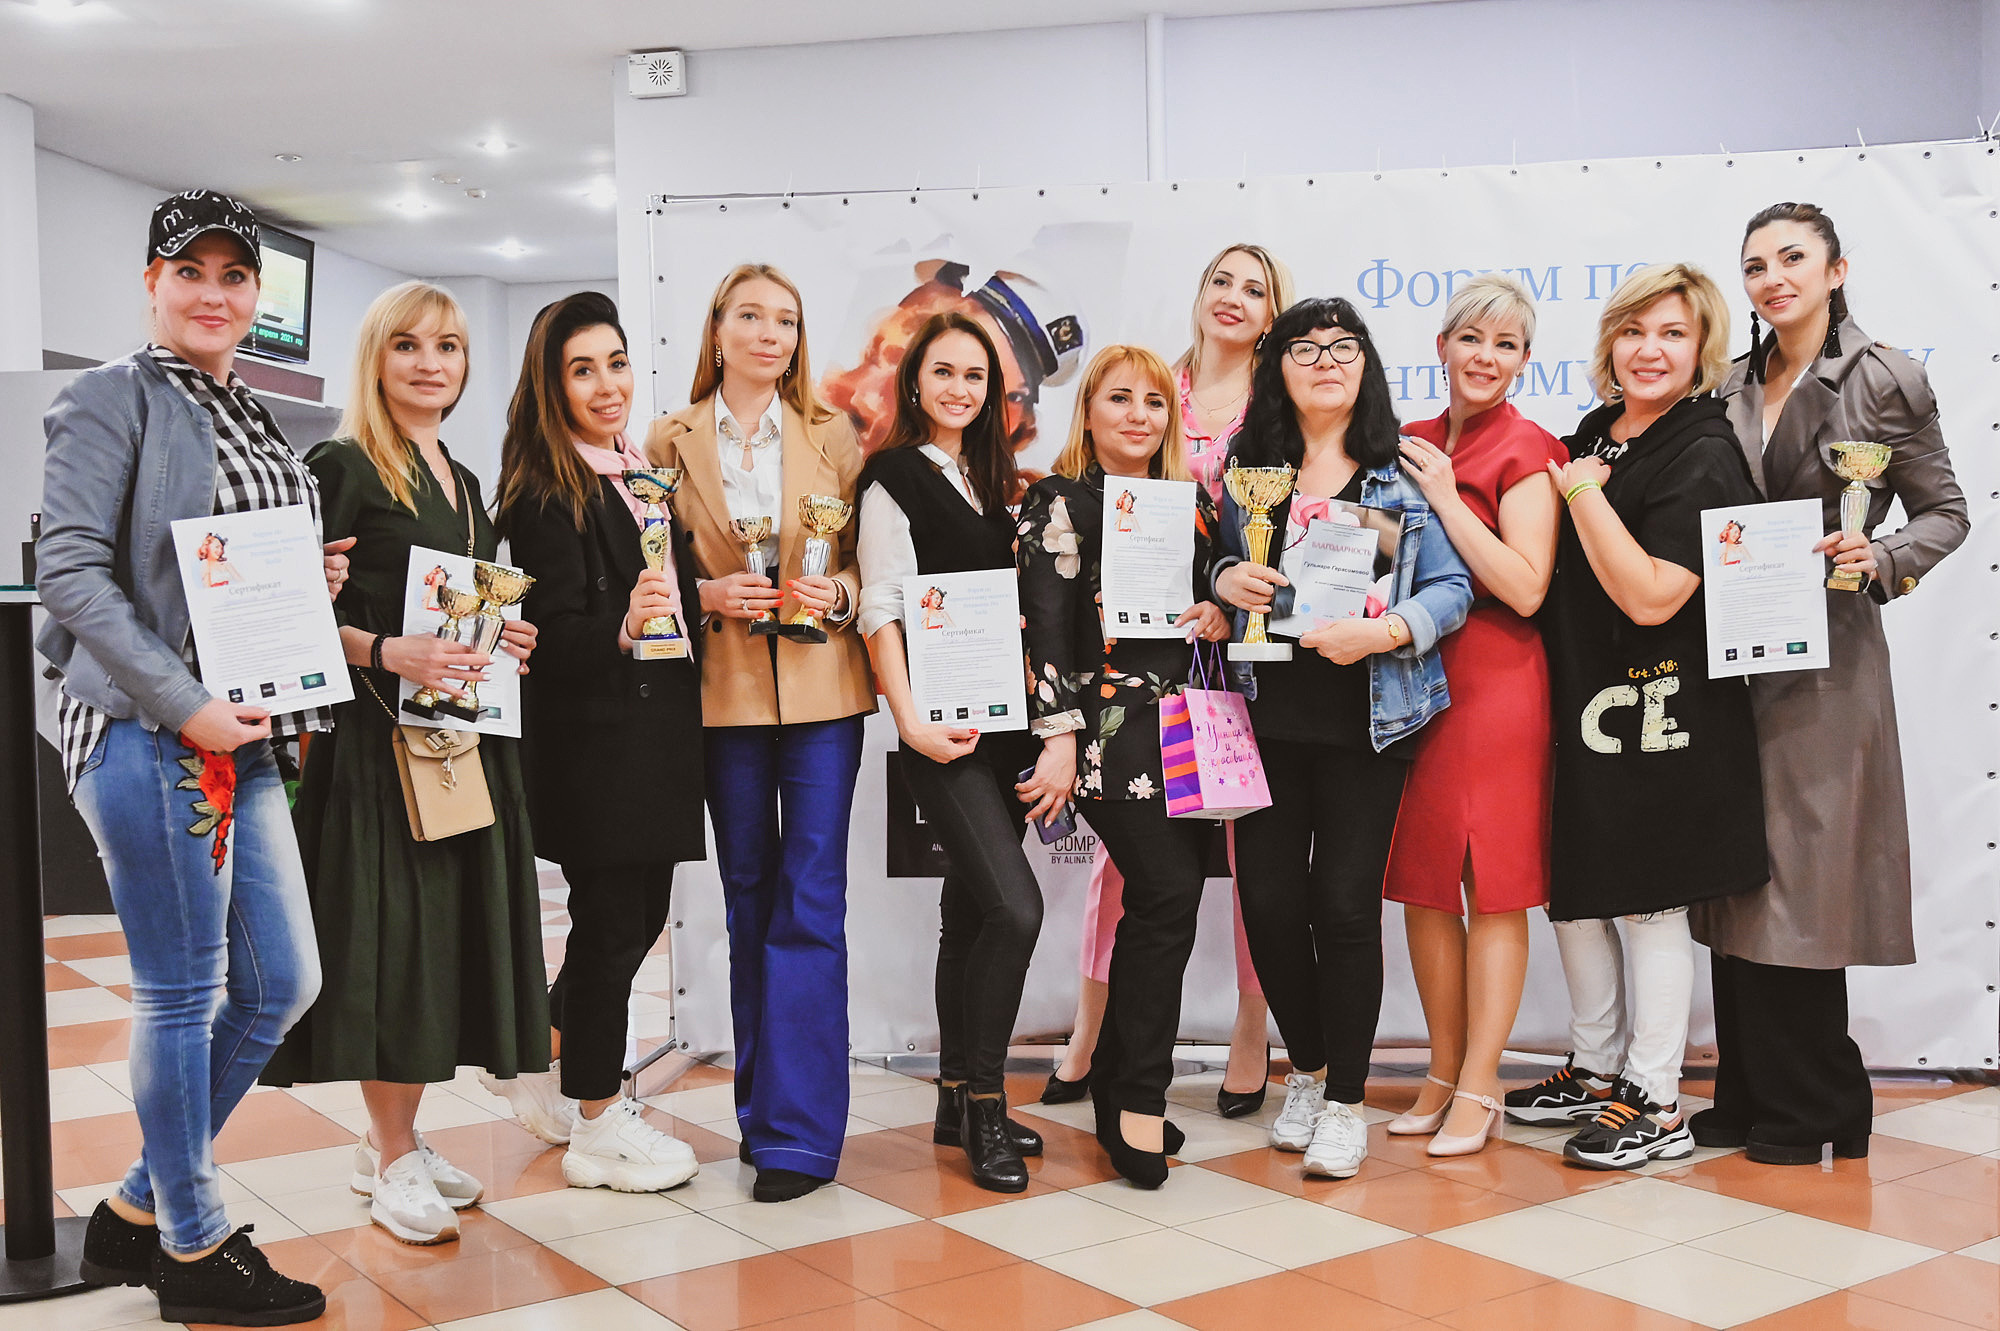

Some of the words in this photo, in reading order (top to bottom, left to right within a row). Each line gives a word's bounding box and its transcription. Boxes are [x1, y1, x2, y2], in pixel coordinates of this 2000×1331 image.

[280, 332, 294, 343] 2021
[1311, 541, 1372, 556] БЛАГОДАРНОСТЬ
[941, 628, 985, 638] Сертификат
[1051, 856, 1062, 864] BY
[1063, 856, 1087, 864] ALINA
